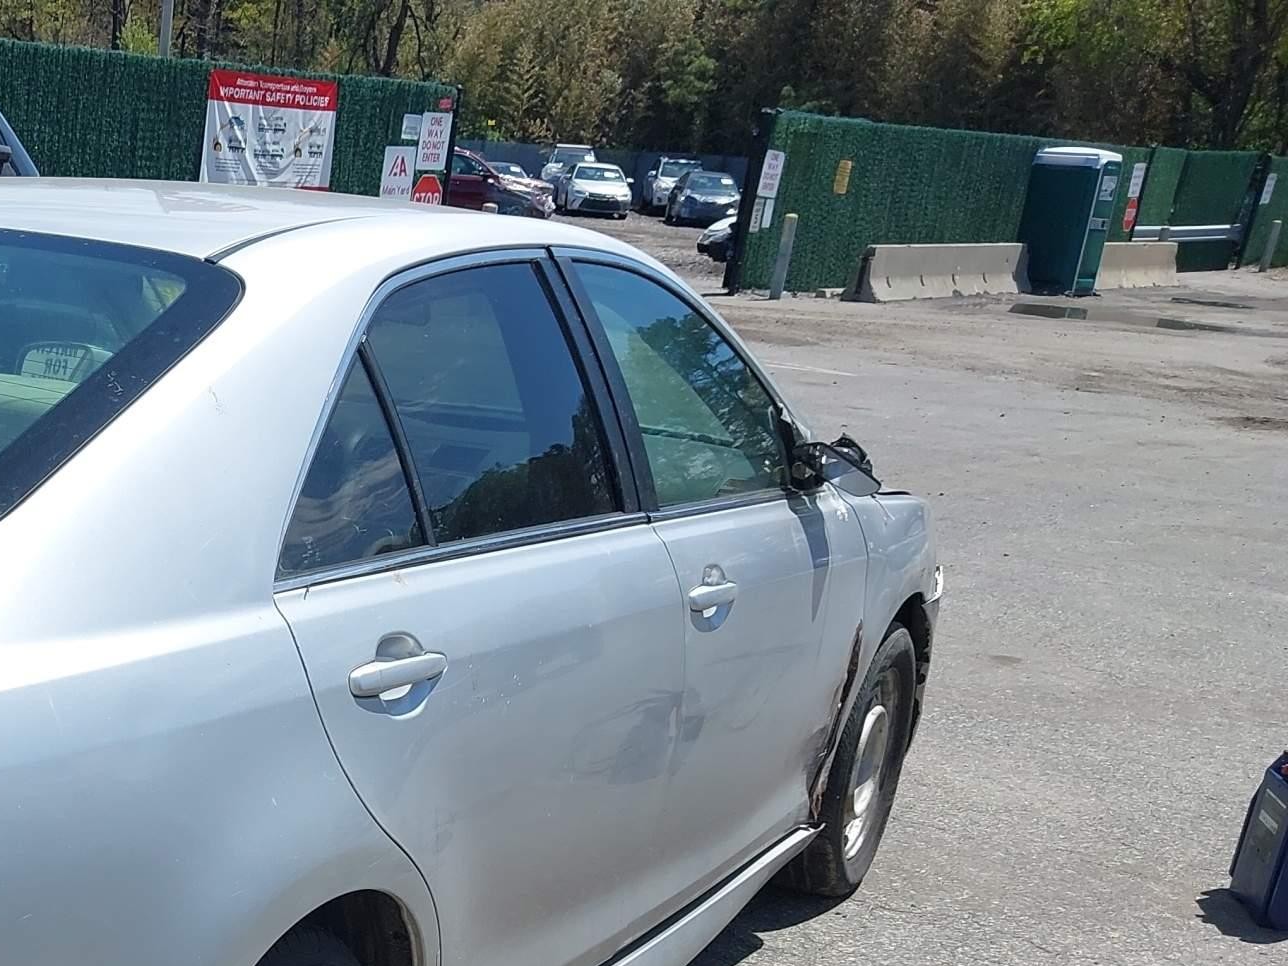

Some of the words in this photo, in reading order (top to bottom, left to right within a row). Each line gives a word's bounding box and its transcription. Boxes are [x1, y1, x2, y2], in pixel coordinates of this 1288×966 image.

[219, 86, 265, 100] IMPORTANT
[265, 92, 294, 104] SAFETY
[295, 95, 330, 107] POLICIES
[430, 117, 443, 127] ONE
[427, 129, 443, 138] WAY
[422, 141, 432, 150] DO
[432, 141, 445, 151] NOT
[422, 153, 441, 162] ENTER
[382, 185, 395, 195] Main
[395, 185, 410, 195] Yard
